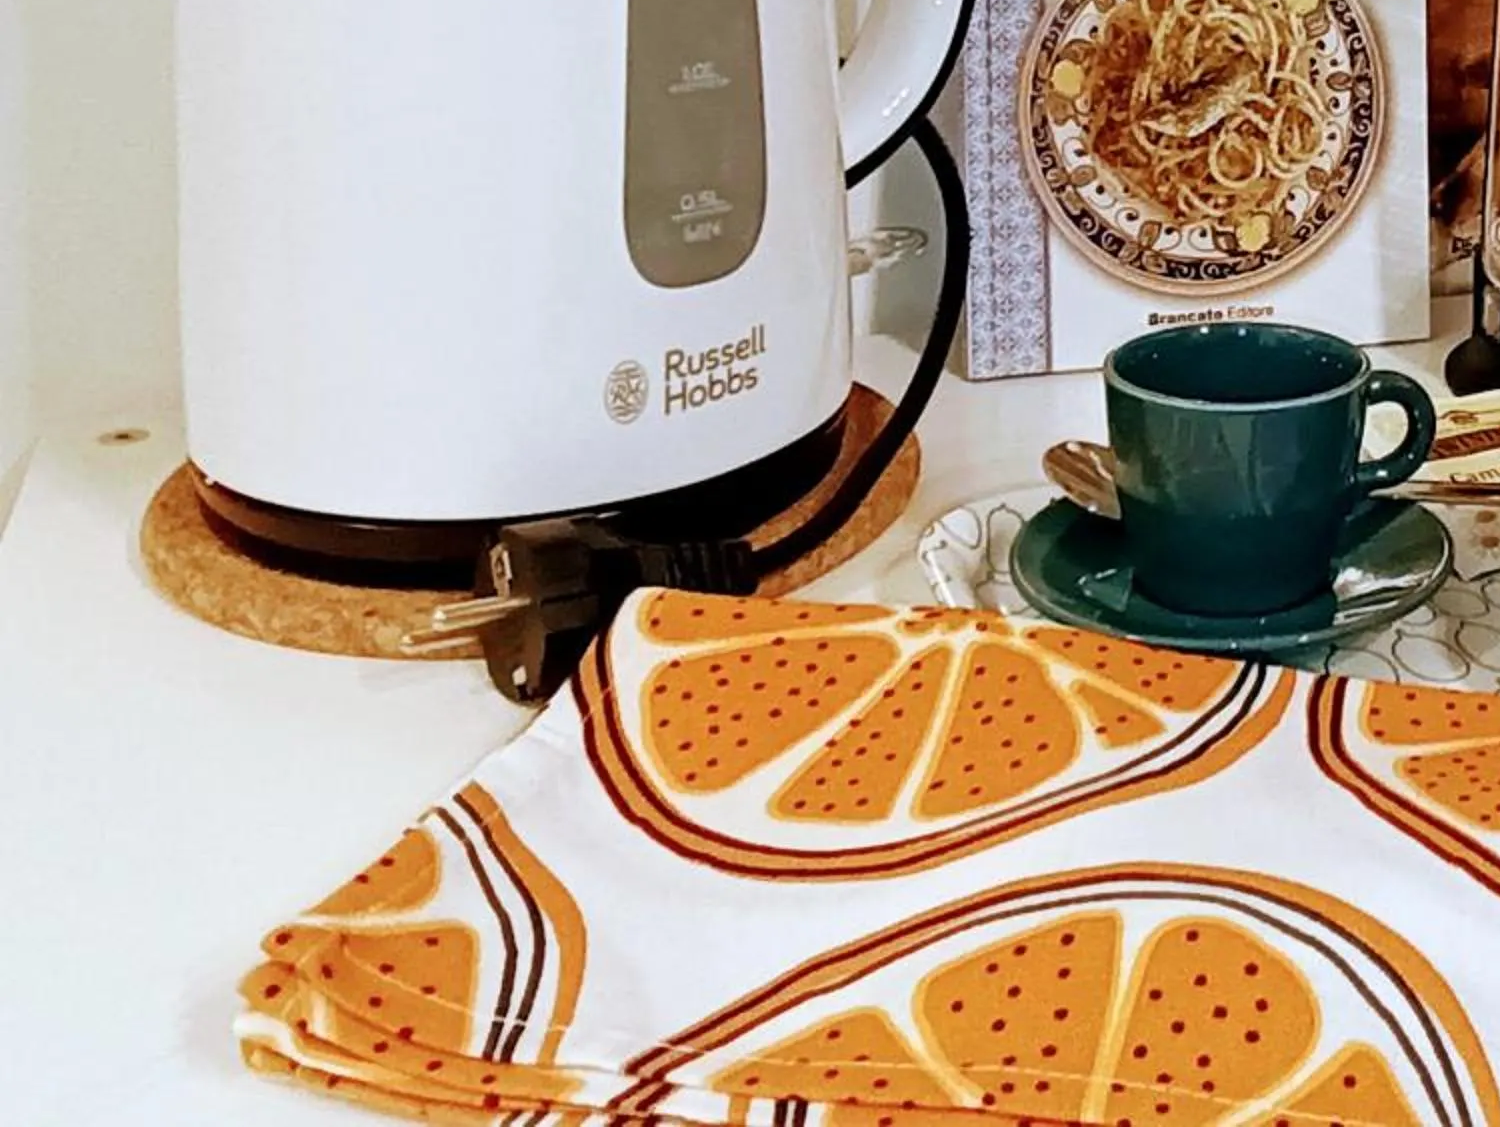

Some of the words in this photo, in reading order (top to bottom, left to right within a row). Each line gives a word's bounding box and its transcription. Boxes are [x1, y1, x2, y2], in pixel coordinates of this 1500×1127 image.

[1147, 306, 1224, 326] Brancato
[663, 322, 766, 382] Russell
[663, 366, 759, 416] Hobbs
